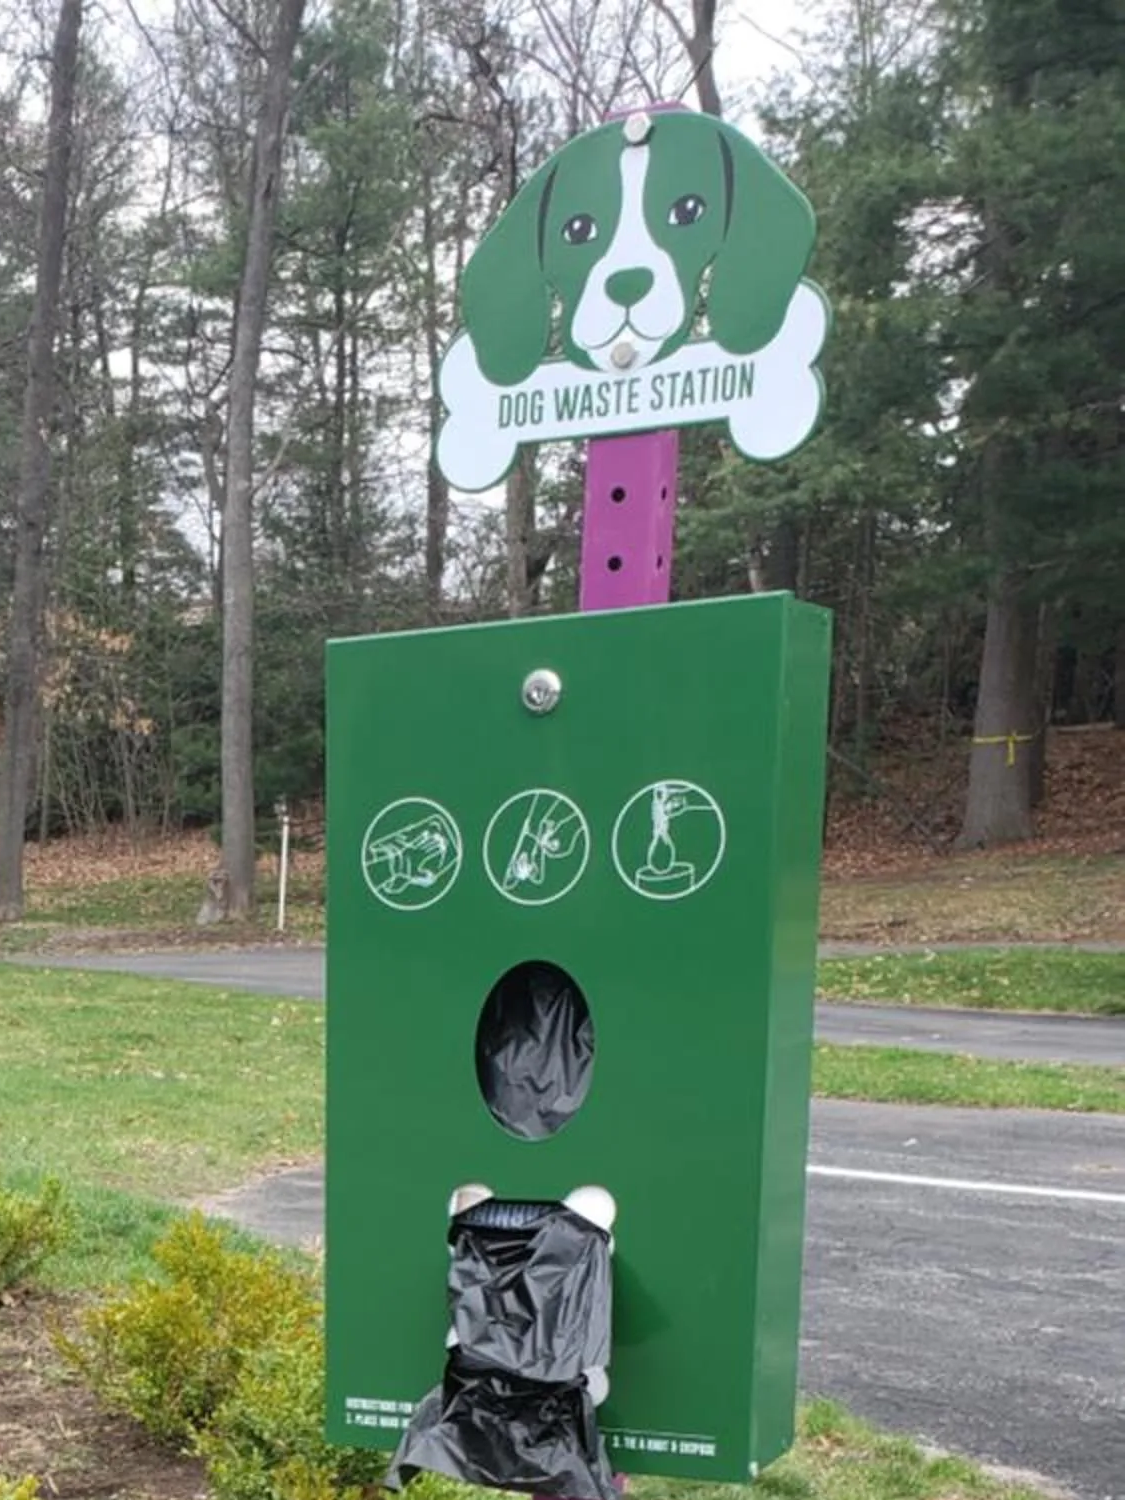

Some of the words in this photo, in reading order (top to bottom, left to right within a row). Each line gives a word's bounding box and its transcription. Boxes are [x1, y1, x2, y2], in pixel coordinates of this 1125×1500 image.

[497, 389, 544, 430] DOG
[554, 376, 641, 422] WASTE
[650, 361, 755, 411] STATION
[638, 1436, 645, 1450] A
